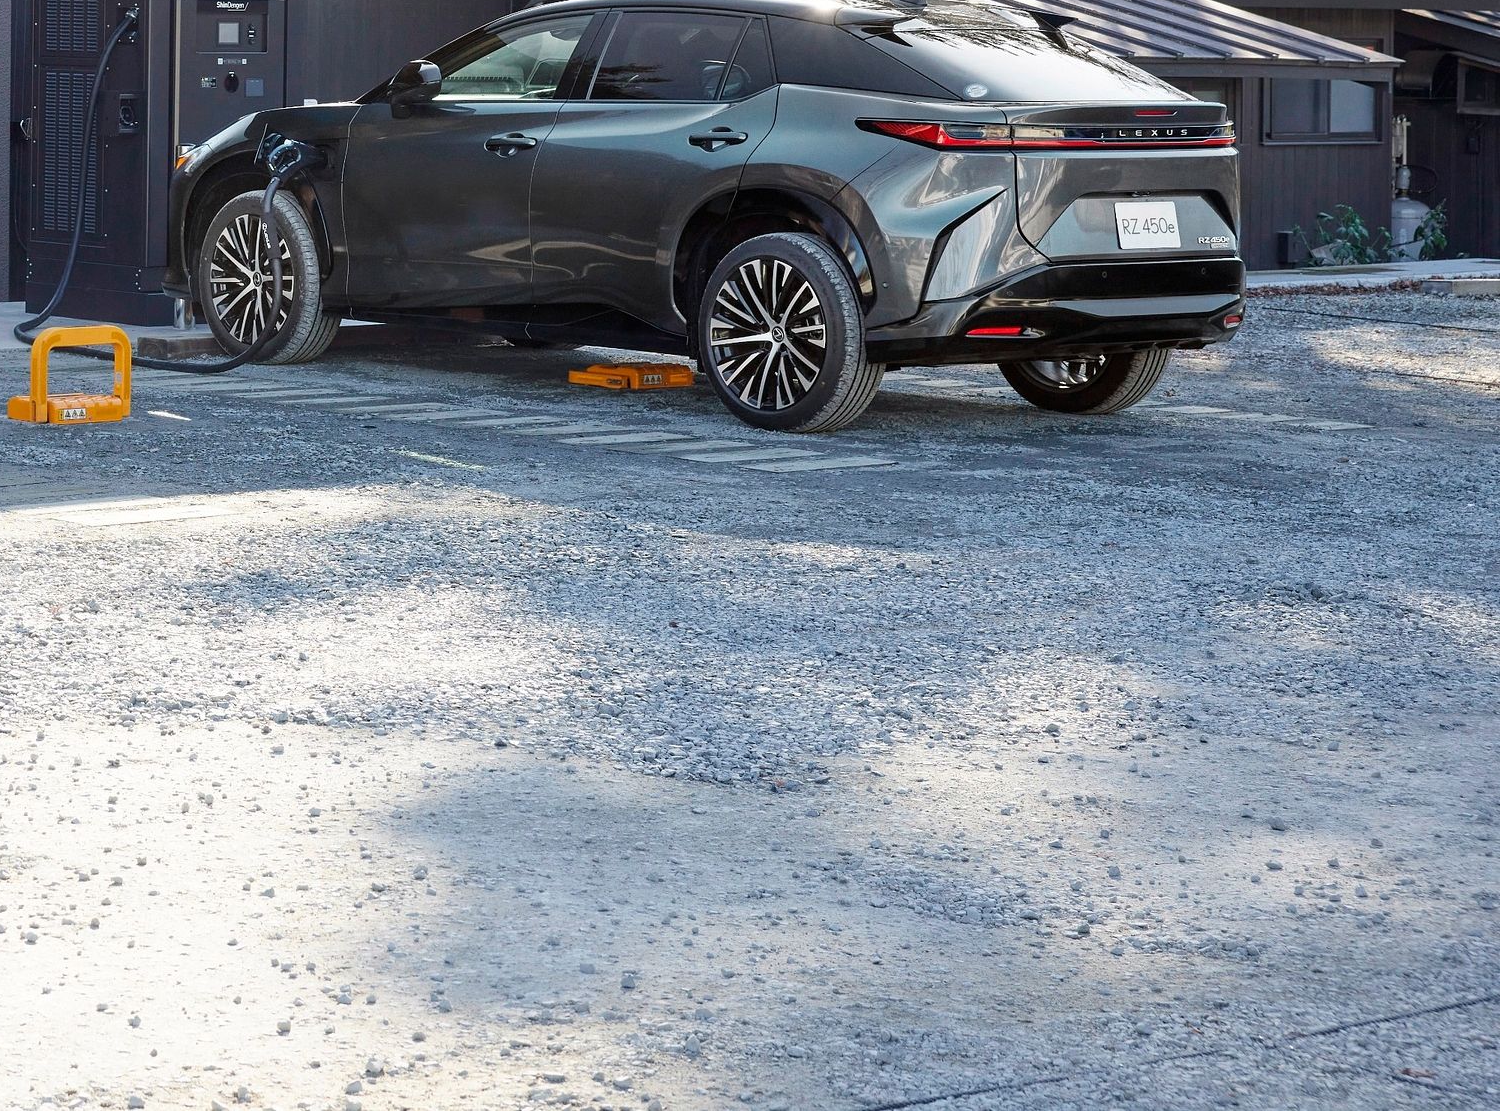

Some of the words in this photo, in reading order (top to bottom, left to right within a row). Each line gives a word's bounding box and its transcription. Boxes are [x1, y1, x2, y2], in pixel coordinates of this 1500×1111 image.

[1118, 129, 1188, 137] LEXUS
[1121, 218, 1140, 235] RZ
[1142, 217, 1176, 234] 450e
